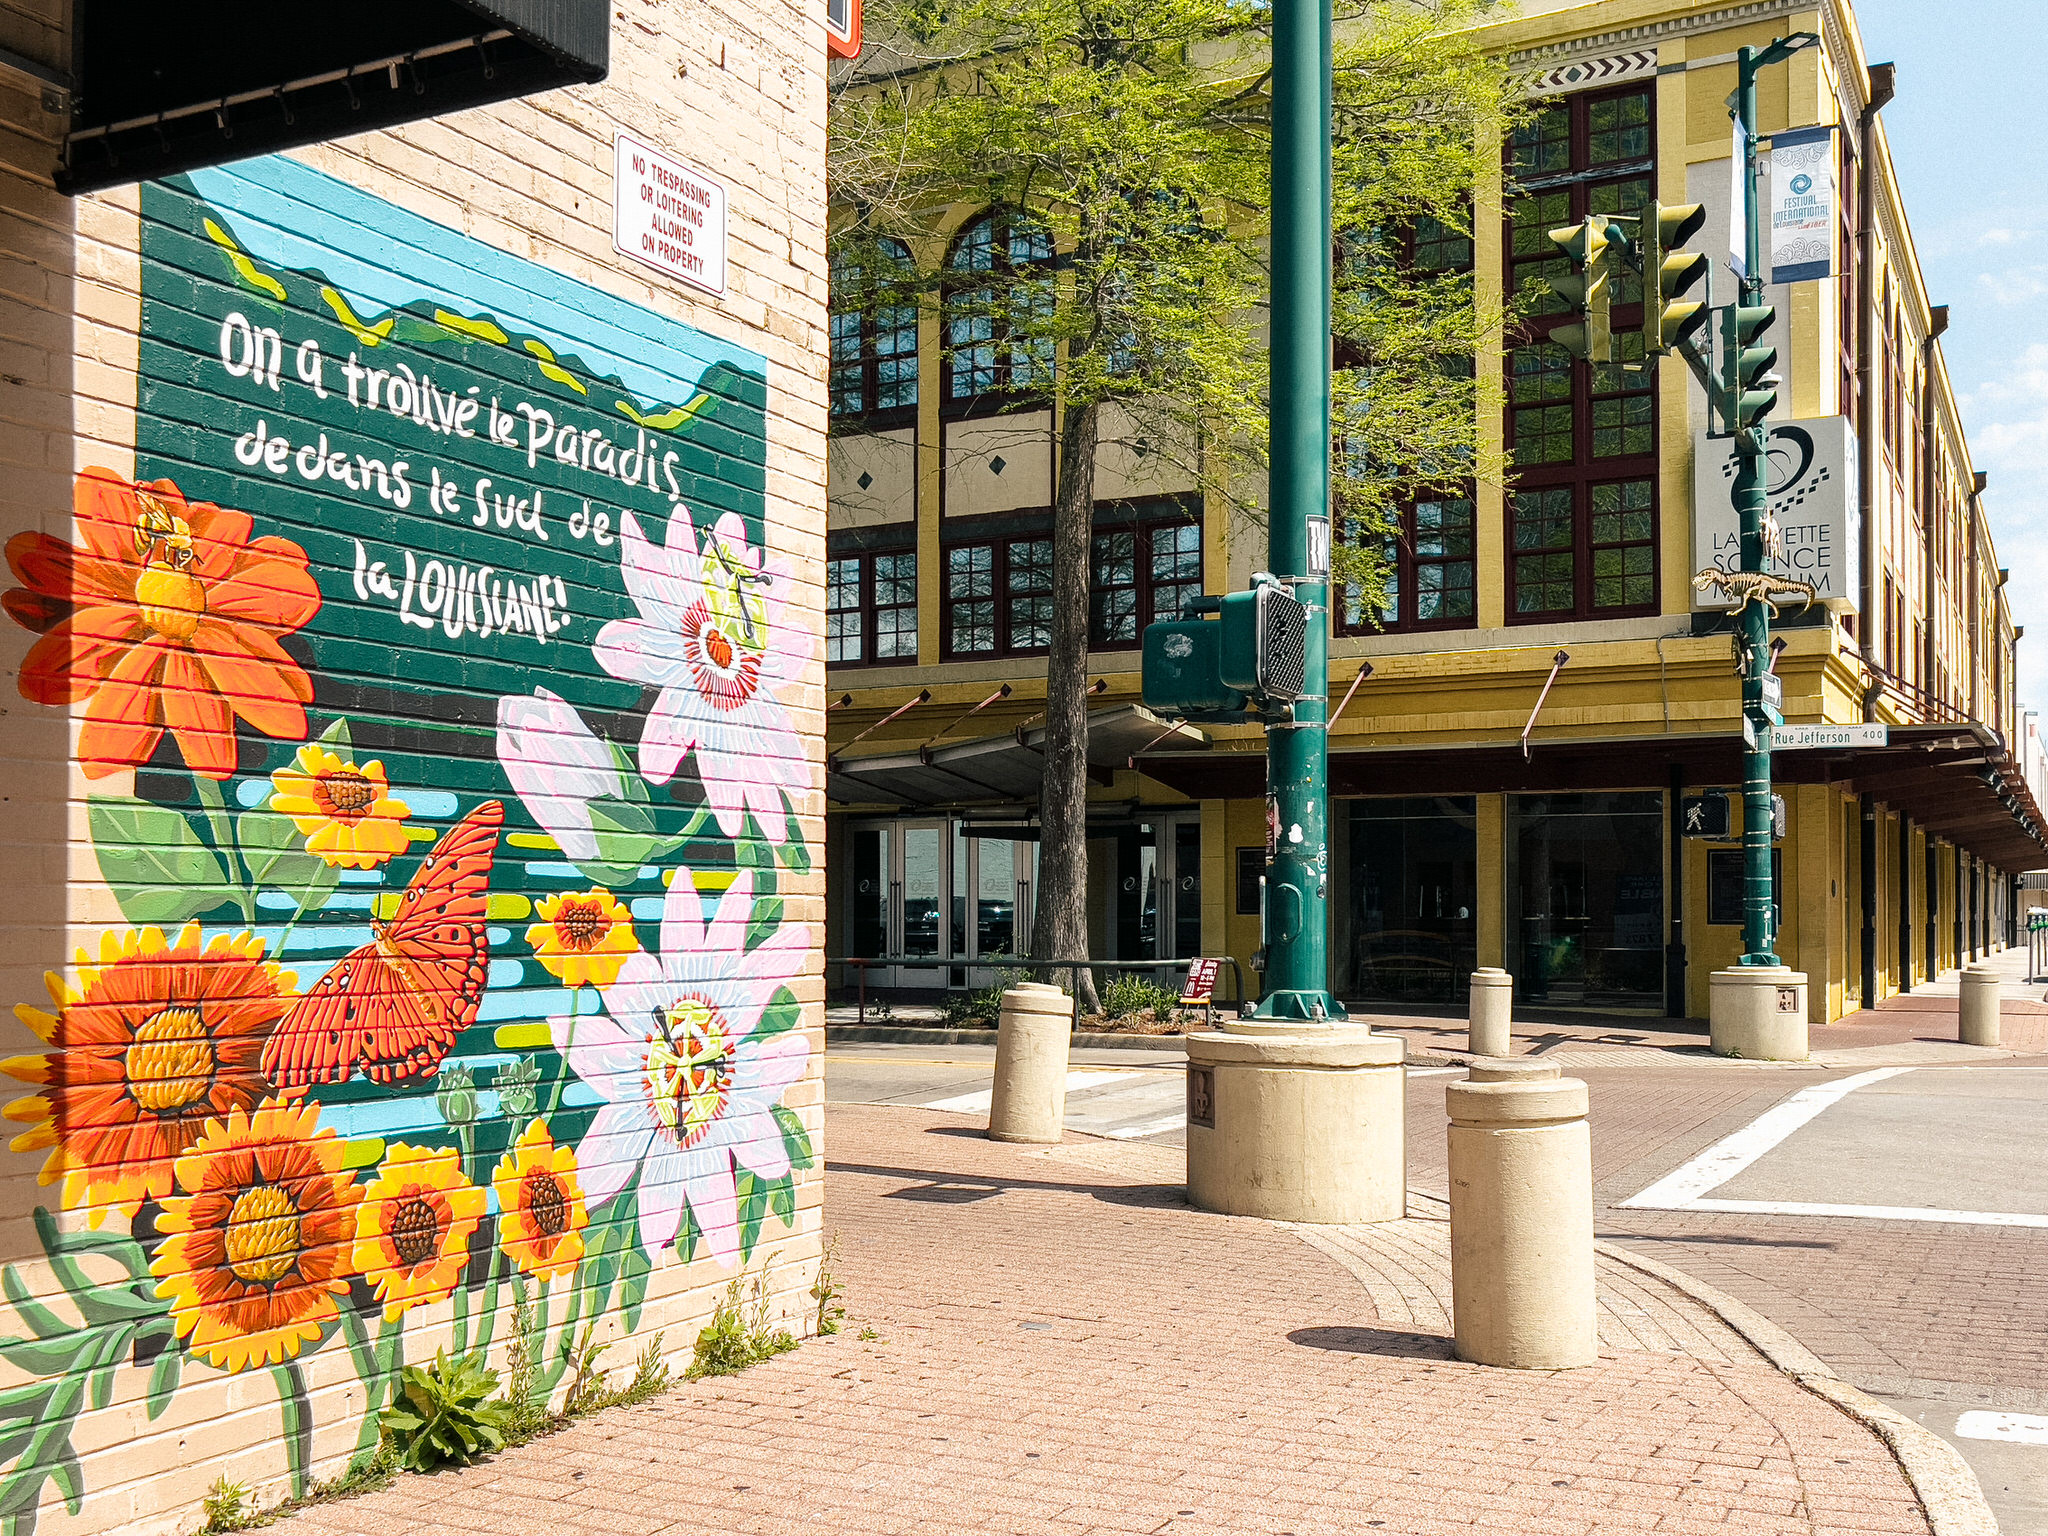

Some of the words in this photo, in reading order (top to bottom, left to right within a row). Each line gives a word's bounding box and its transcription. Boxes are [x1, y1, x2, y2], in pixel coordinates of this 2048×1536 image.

[632, 153, 646, 175] NO
[651, 164, 711, 208] TRESPASSING
[640, 183, 653, 204] OR
[656, 190, 703, 228] LOITERING
[1772, 205, 1829, 222] INTERNATIONAL
[1783, 195, 1816, 209] FESTIVAL
[652, 213, 693, 247] ALLOWED
[642, 233, 655, 254] ON
[658, 241, 704, 275] PROPERTY
[220, 312, 282, 392] On
[298, 339, 328, 398] a
[490, 397, 519, 447] le
[517, 402, 681, 501] Paradis
[430, 467, 460, 514] le
[568, 499, 614, 546] de
[1713, 524, 1831, 550] LAETTE
[353, 538, 399, 601] la
[400, 551, 571, 645] LOUISIANE!
[1775, 733, 1794, 744] Rue
[1797, 731, 1850, 744] Jefferson
[1862, 730, 1883, 739] 400
